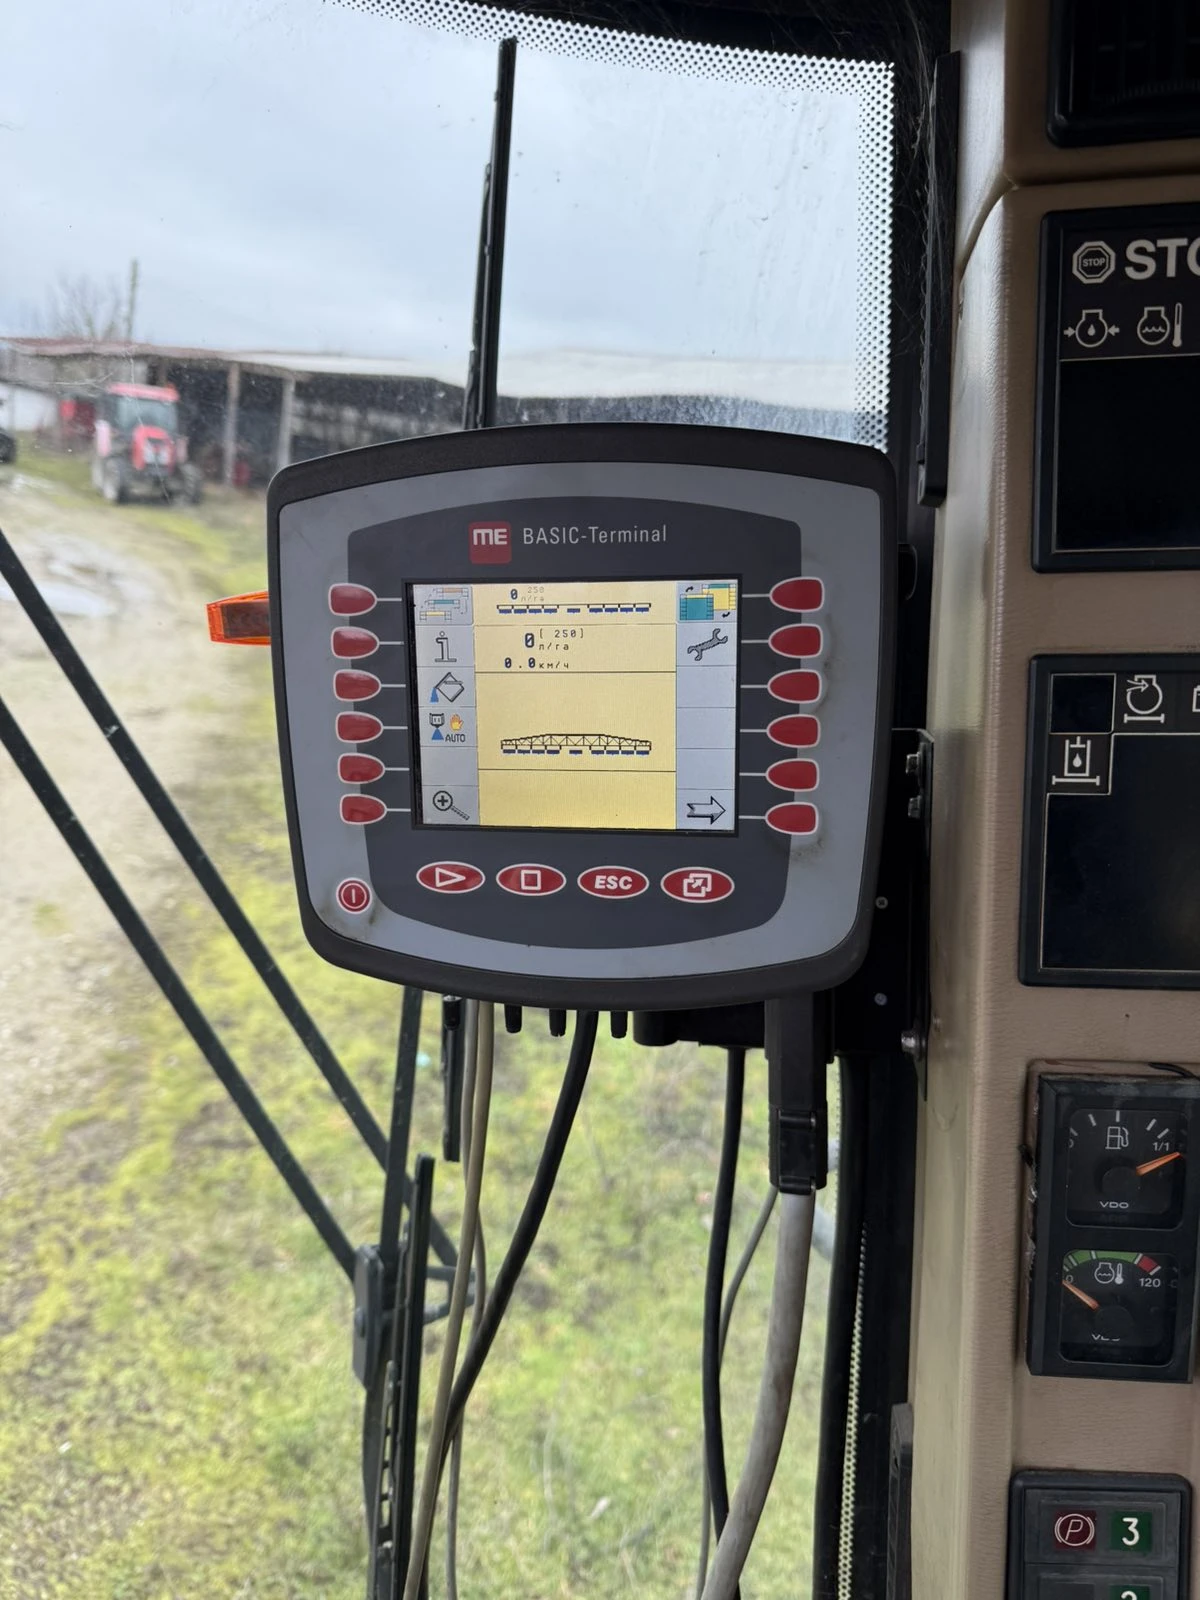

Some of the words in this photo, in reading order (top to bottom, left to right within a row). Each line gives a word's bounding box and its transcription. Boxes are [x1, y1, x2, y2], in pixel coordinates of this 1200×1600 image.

[1082, 257, 1106, 268] STOP
[523, 524, 667, 545] BASIC-Terminal
[527, 586, 545, 594] 250
[524, 632, 535, 649] 0
[445, 733, 466, 743] AUTO
[594, 875, 633, 890] ESC
[1152, 1141, 1170, 1151] 1/1
[1099, 1201, 1129, 1209] VDO
[1139, 1277, 1161, 1288] 120
[1121, 1517, 1140, 1546] 3
